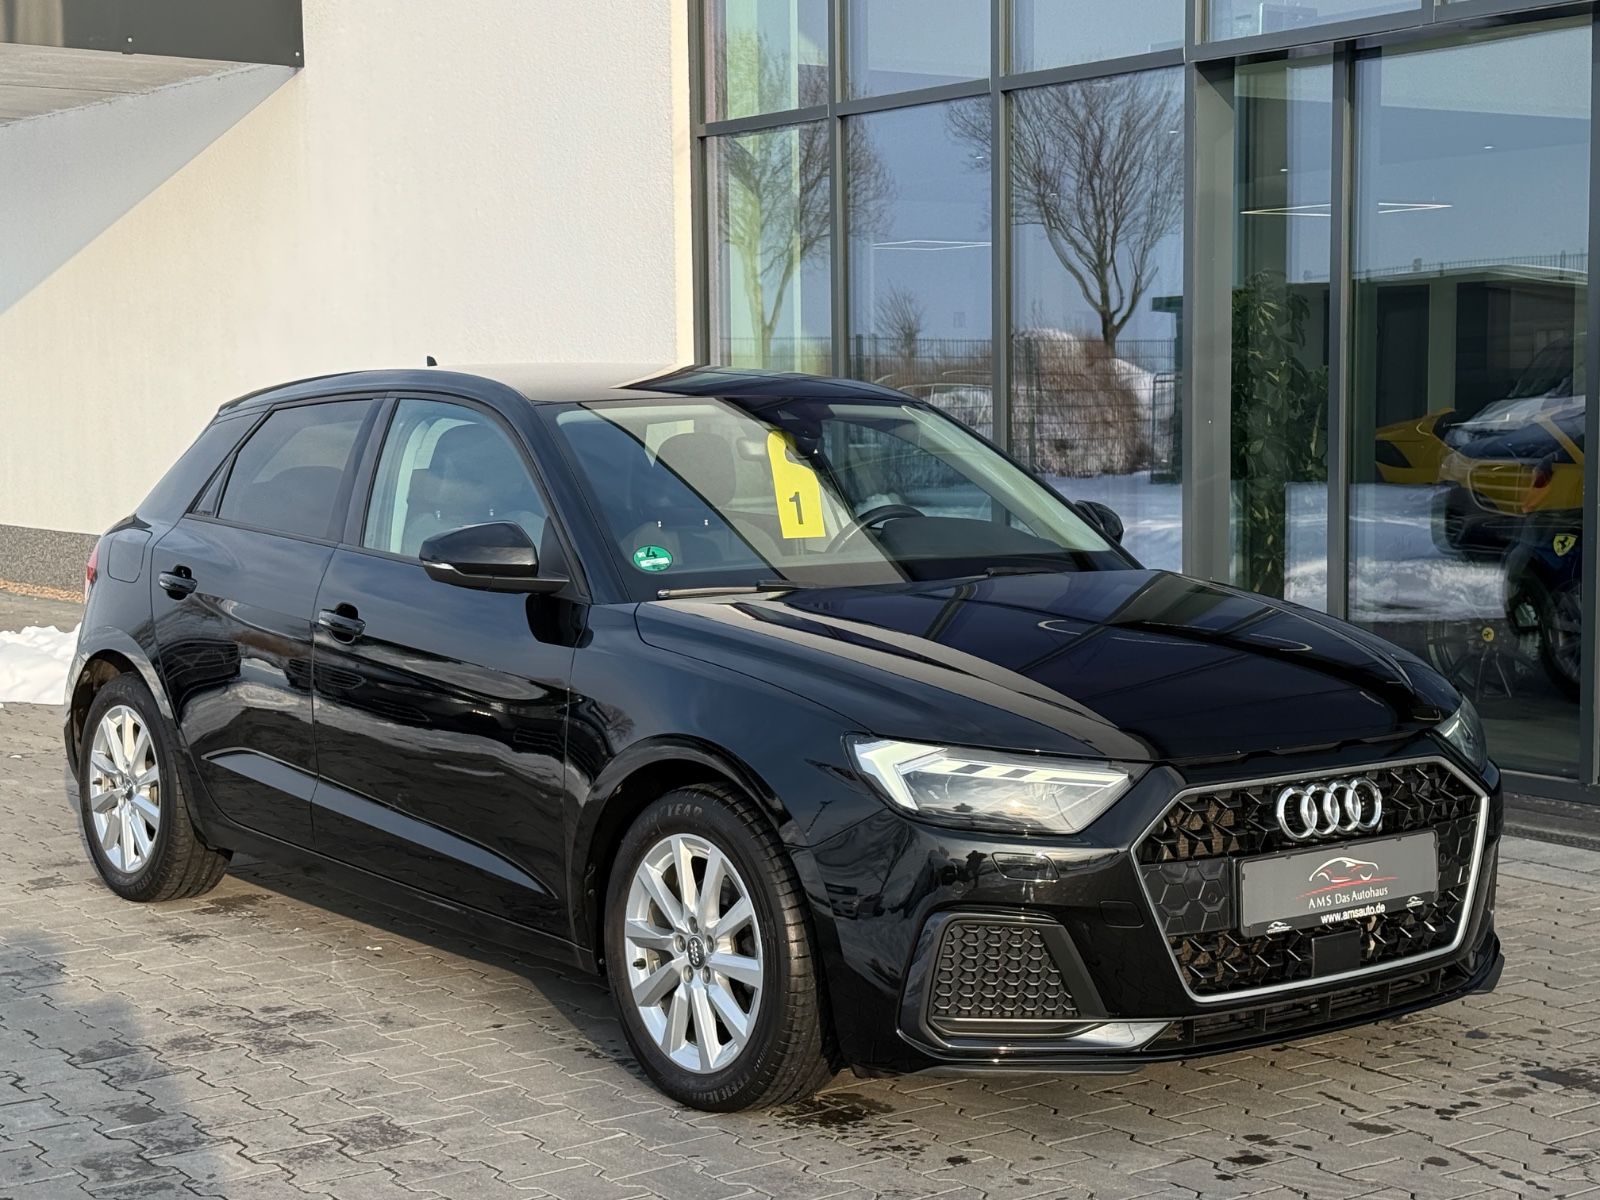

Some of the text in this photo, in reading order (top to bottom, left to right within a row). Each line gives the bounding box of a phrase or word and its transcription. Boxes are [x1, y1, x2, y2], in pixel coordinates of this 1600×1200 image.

[788, 491, 804, 525] 1
[646, 546, 658, 558] 4
[1308, 886, 1388, 909] AMS Das Autohaus
[1320, 902, 1386, 924] www.amsauto.de
